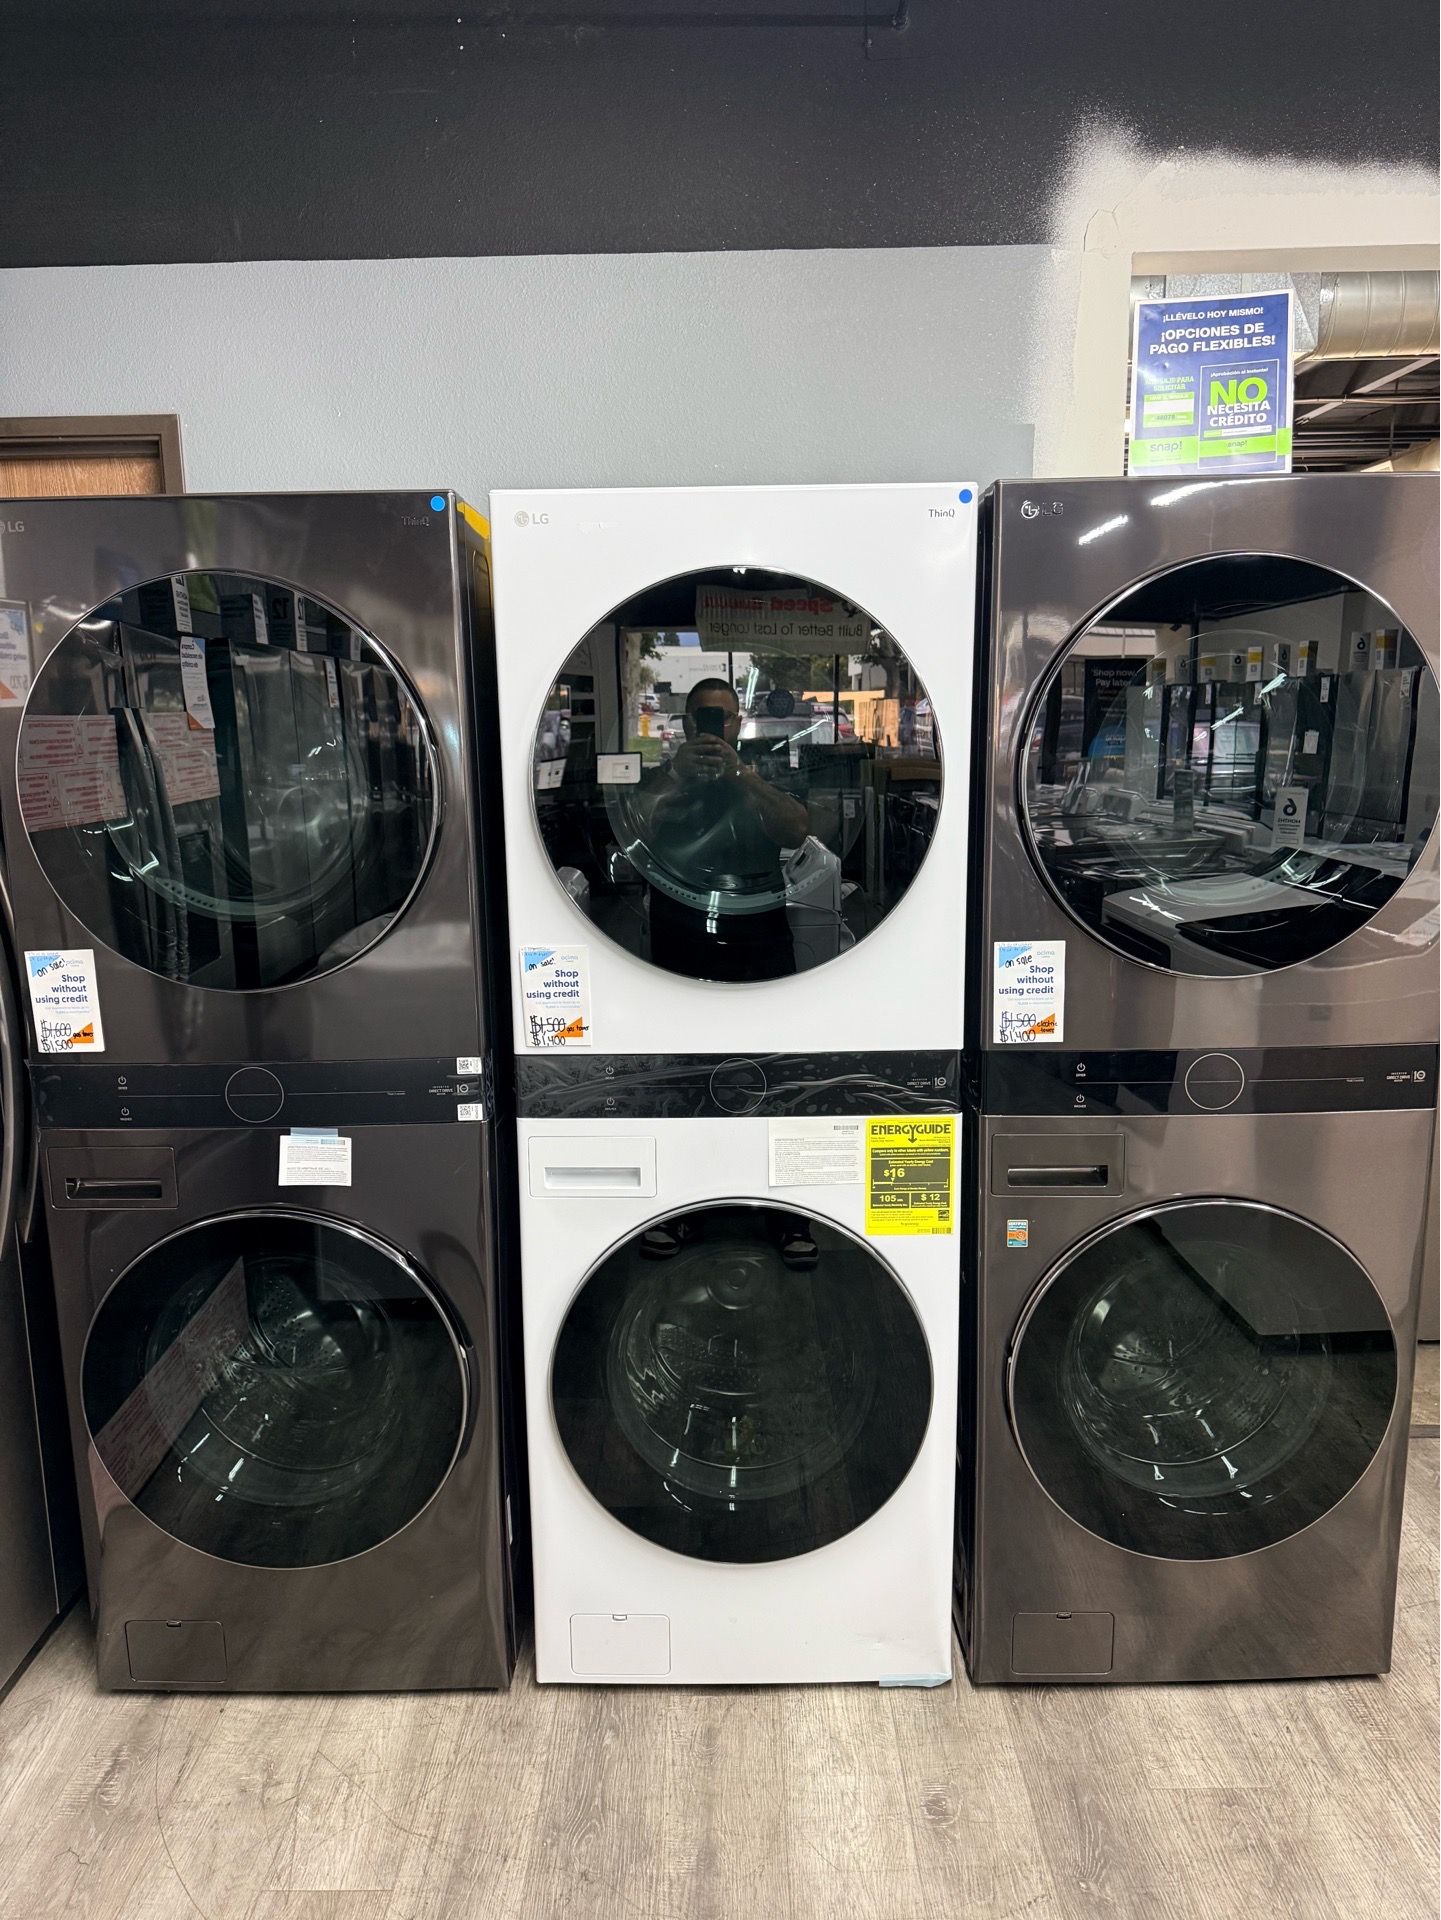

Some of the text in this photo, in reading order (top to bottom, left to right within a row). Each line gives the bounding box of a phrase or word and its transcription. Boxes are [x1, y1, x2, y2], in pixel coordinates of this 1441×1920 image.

[1163, 307, 1264, 322] ¡LLÉVELO HOY MISMO!
[1161, 323, 1265, 342] ¡OPCIONES DE
[1150, 335, 1276, 355] PAGO FLEXIBLES!
[1209, 376, 1268, 407] NO
[1207, 400, 1271, 416] NECESITA
[1209, 412, 1267, 427] CRÉDITO
[1150, 441, 1182, 454] snap!
[928, 508, 955, 519] ThinQ
[1041, 501, 1064, 517] LG
[532, 513, 549, 525] LG
[7, 520, 25, 532] LG
[1093, 669, 1115, 677] Shop
[1096, 679, 1111, 688] Pay
[555, 969, 579, 979] Shop
[1029, 965, 1054, 974] Shop
[61, 974, 86, 984] Shop
[543, 979, 580, 988] without
[1017, 975, 1054, 984] without
[51, 984, 87, 993] without
[998, 985, 1054, 996] using credit
[35, 994, 89, 1005] using credit
[526, 989, 580, 1000] using credit
[531, 1033, 566, 1047] $1,400
[999, 1029, 1036, 1043] $1,400
[41, 1038, 74, 1053] $1,500
[871, 1124, 951, 1135] ENERGYGUIDE
[883, 1168, 905, 1178] $16
